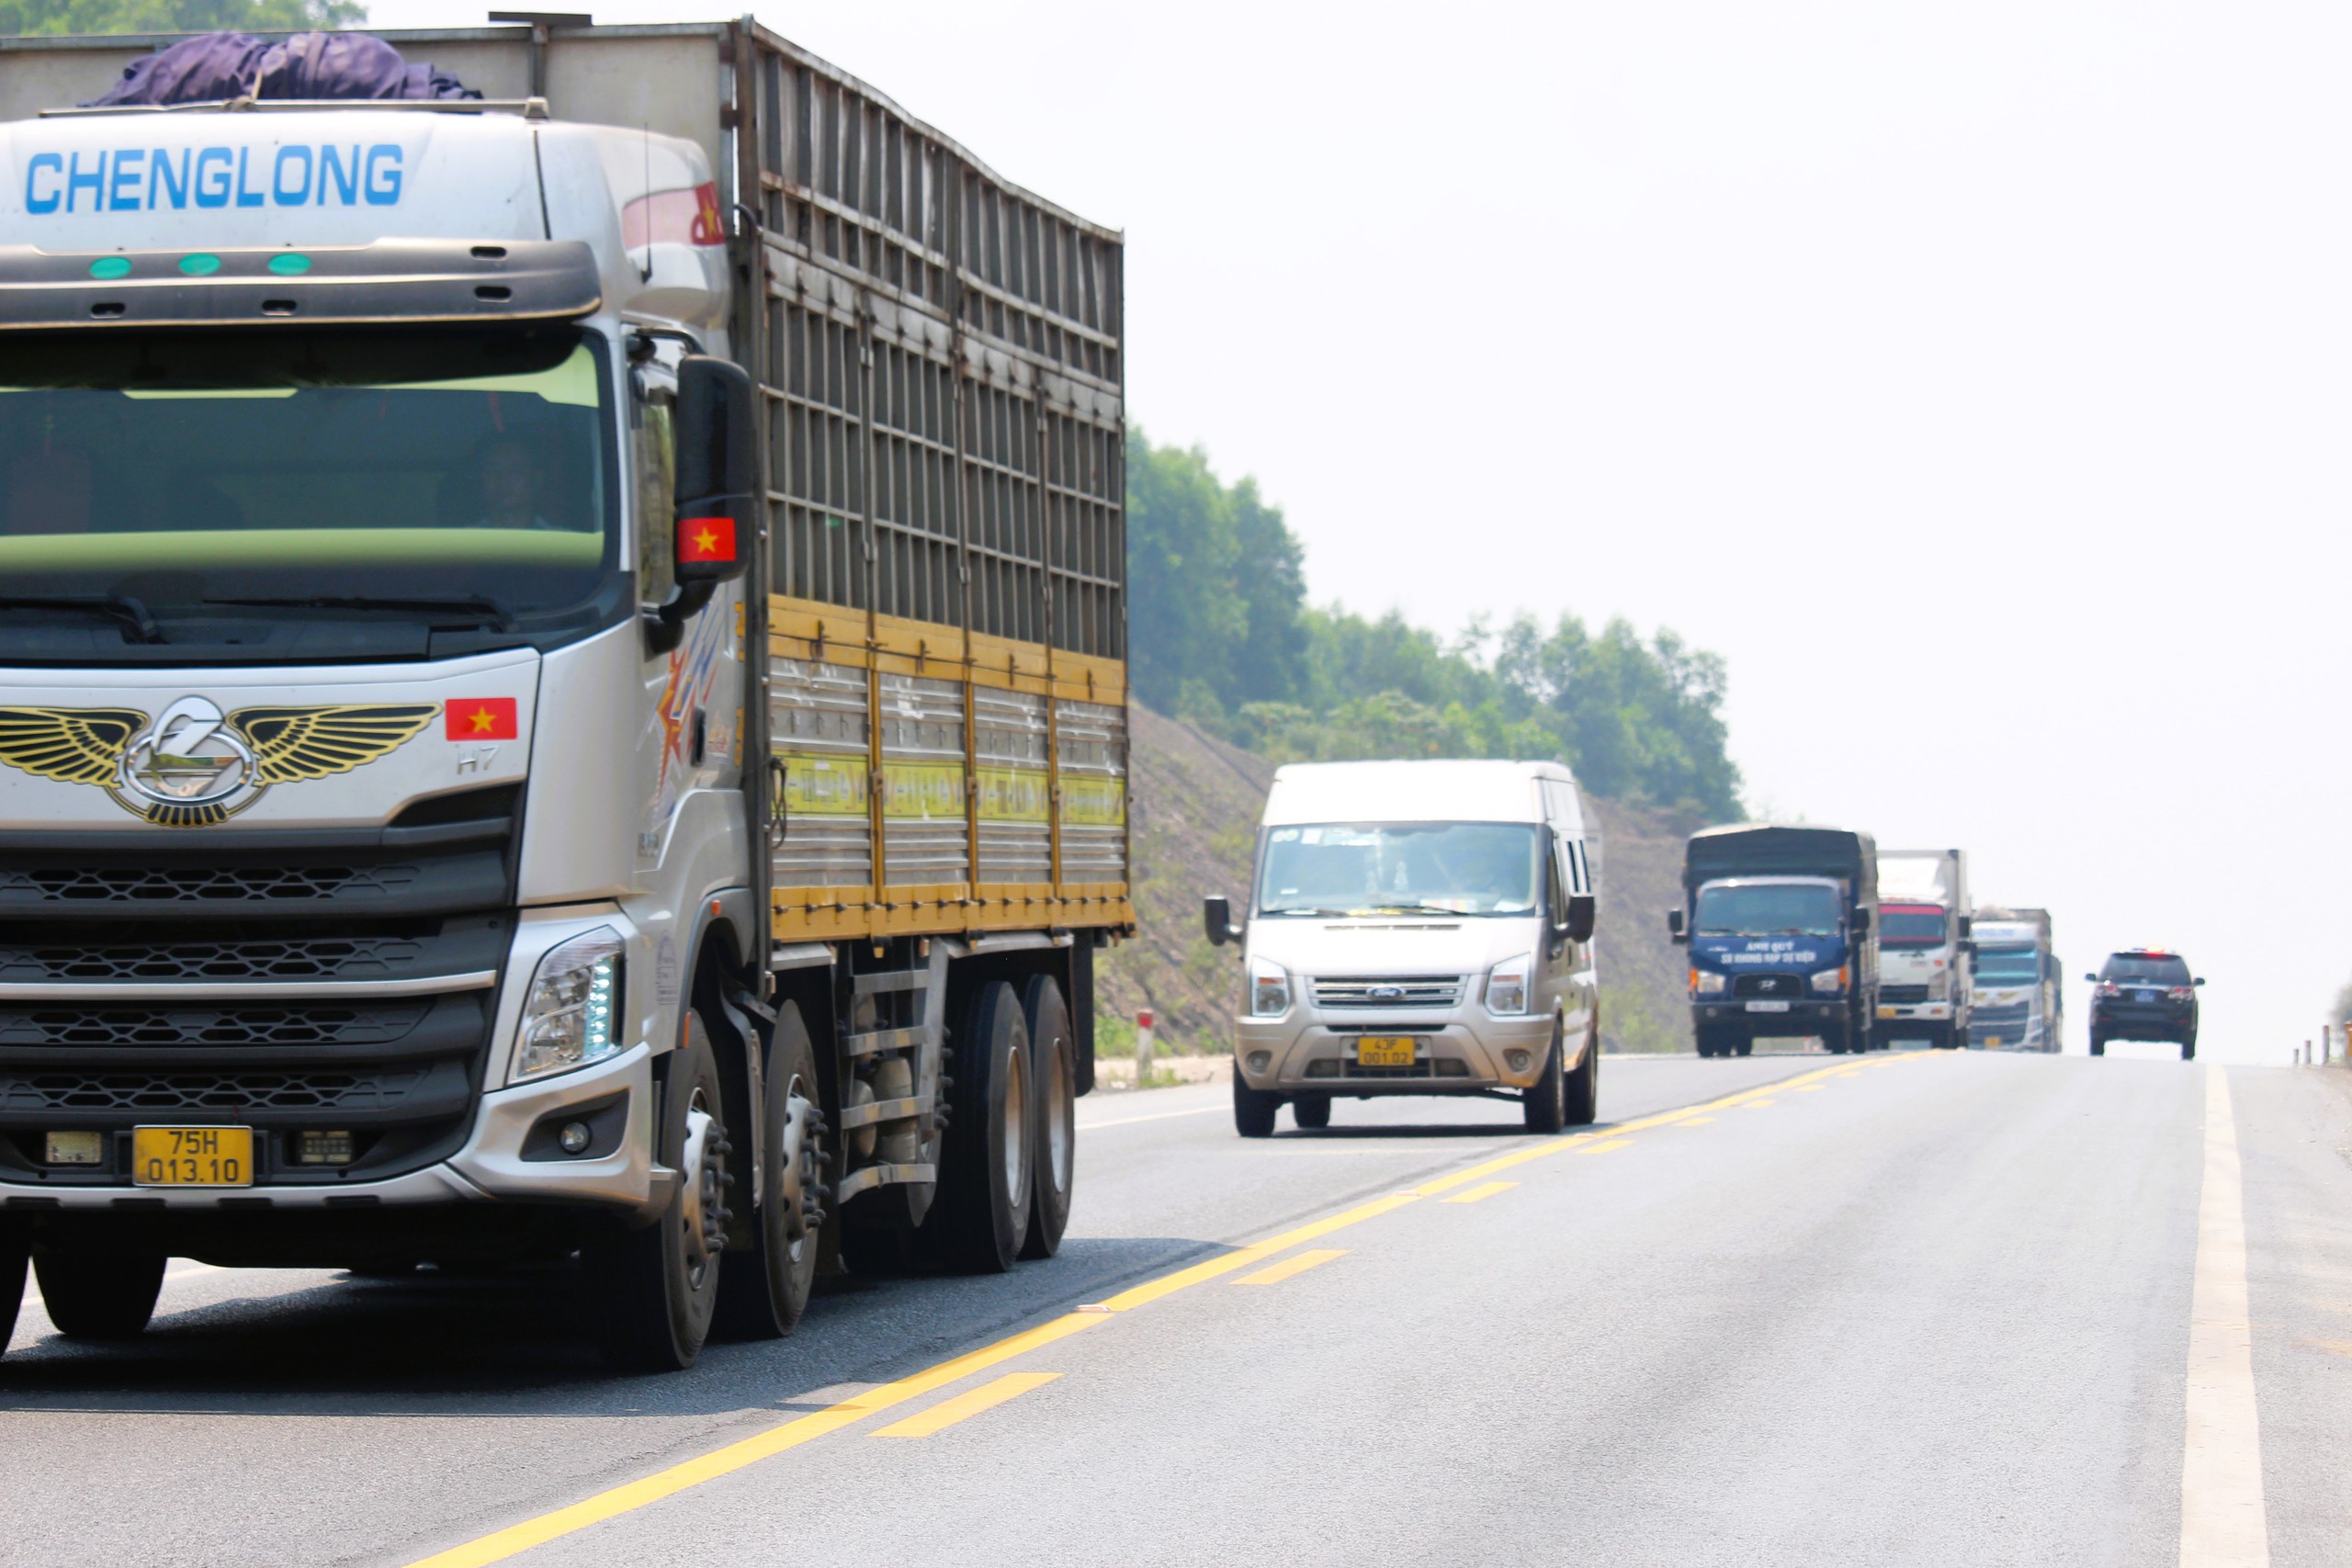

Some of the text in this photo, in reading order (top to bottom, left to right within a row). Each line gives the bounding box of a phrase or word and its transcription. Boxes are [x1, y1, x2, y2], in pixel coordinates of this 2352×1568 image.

[25, 144, 403, 215] CHENGLONG
[456, 744, 500, 775] H7
[1374, 1038, 1396, 1050] 43F
[1363, 1053, 1408, 1064] 001.02
[168, 1131, 218, 1155] 75H
[148, 1158, 239, 1182] 013.10
